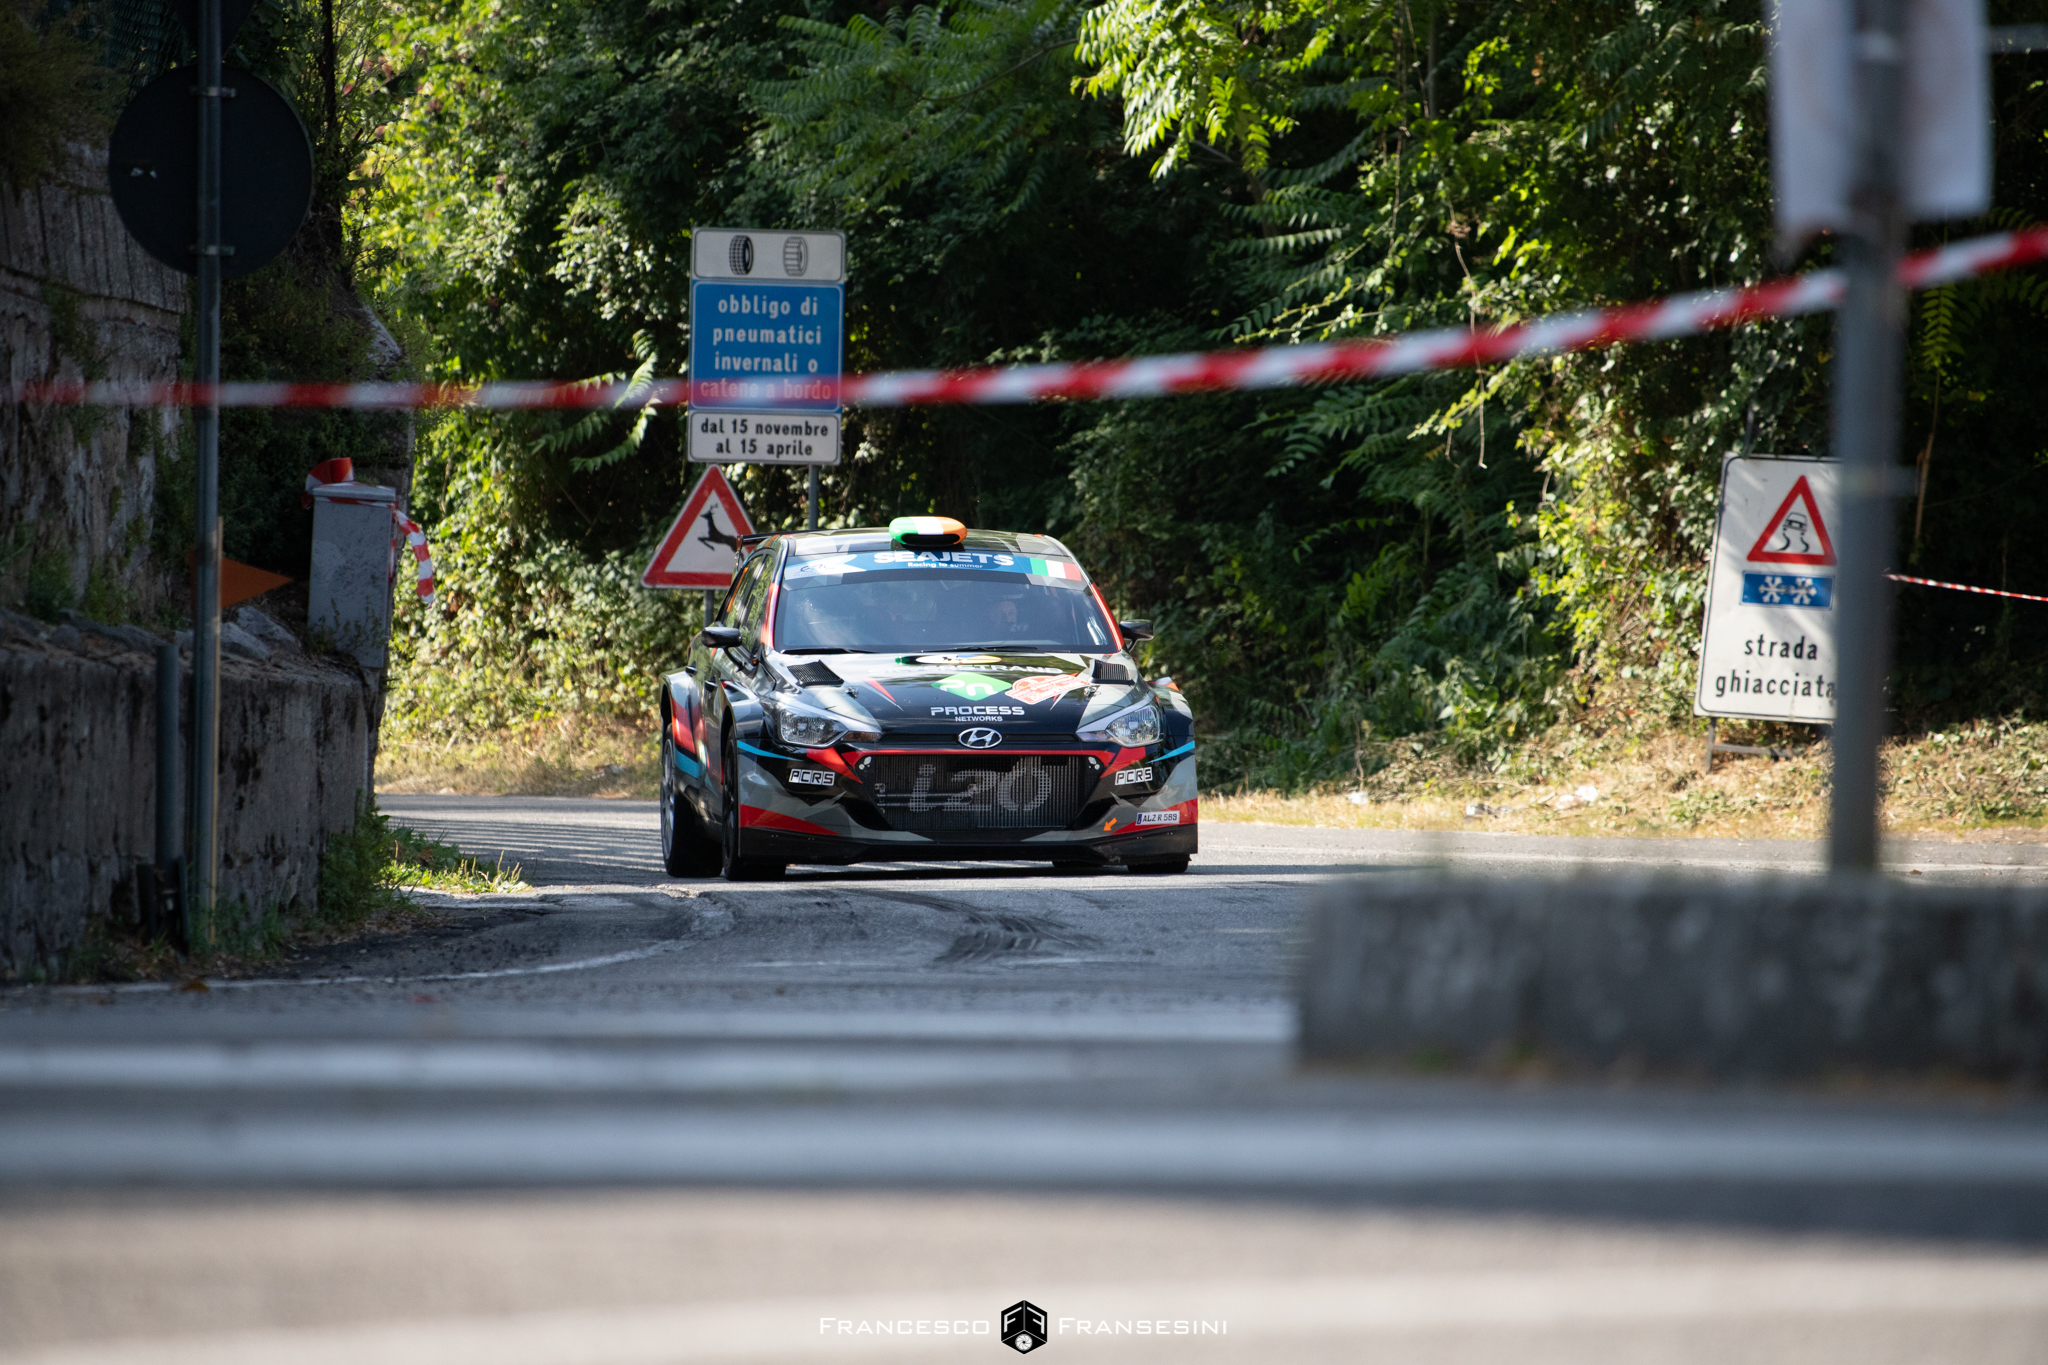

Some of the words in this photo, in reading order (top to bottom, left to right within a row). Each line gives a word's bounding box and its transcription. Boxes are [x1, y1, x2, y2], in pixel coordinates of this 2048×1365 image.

[718, 294, 791, 319] obbligo
[800, 296, 818, 316] di
[712, 325, 822, 345] pneumatici
[714, 351, 798, 373] invernali
[807, 358, 818, 373] o
[700, 377, 760, 398] catene
[766, 383, 776, 399] a
[783, 378, 832, 400] bordo
[701, 418, 725, 434] dal
[732, 418, 748, 434] 15
[755, 419, 829, 436] novembre
[715, 438, 731, 454] al
[740, 438, 757, 454] 15
[766, 440, 813, 458] aprile
[873, 551, 1015, 566] SEAJETS
[1743, 633, 1819, 660] strada
[930, 706, 1026, 716] PROCESS
[790, 770, 835, 785] PCRS
[1116, 768, 1152, 784] PCRS
